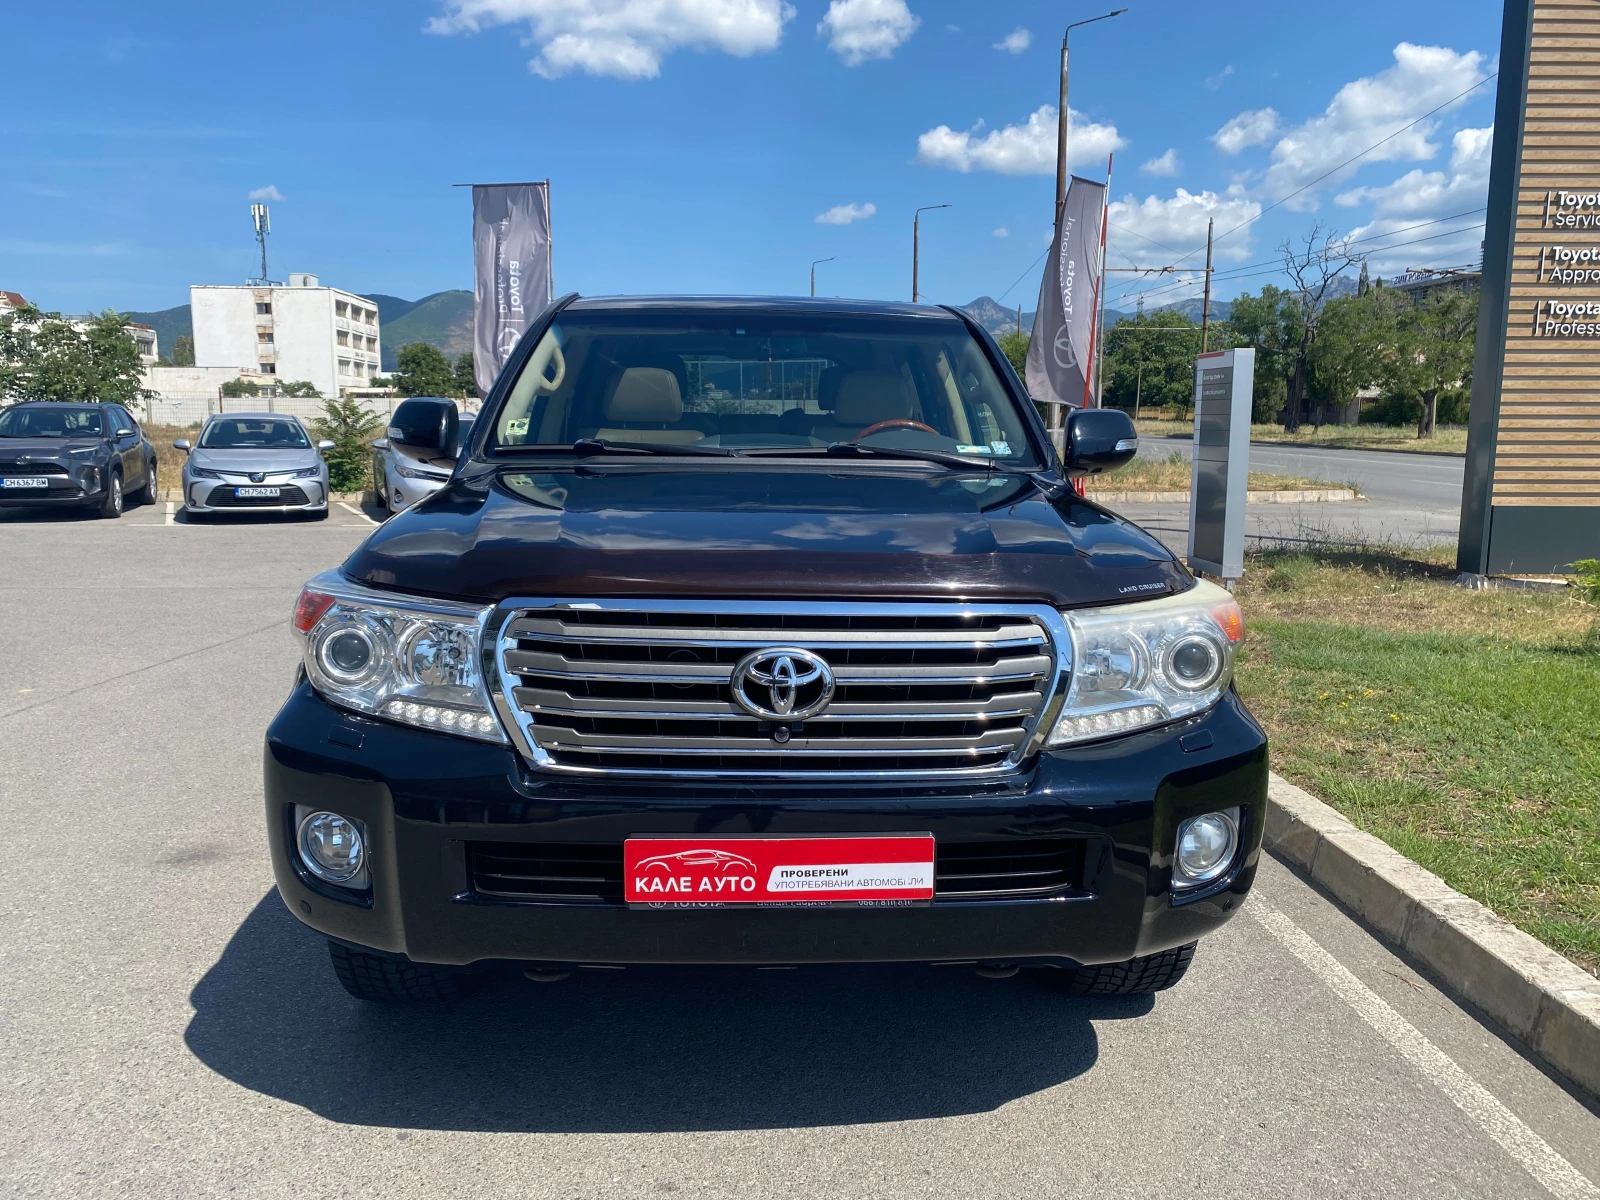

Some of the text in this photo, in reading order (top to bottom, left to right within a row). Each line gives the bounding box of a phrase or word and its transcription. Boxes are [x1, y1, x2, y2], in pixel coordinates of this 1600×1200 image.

[1553, 246, 1600, 264] Toyot
[1548, 300, 1600, 318] Toyota
[240, 488, 250, 496] CH
[251, 488, 268, 496] 7562
[1118, 582, 1166, 593] LAND CRUISER
[780, 869, 849, 878] ПРОВЕРЕНИ
[635, 876, 756, 893] КАЛЕ АУТО
[774, 879, 854, 889] УПОТРЕБЯВАНИ
